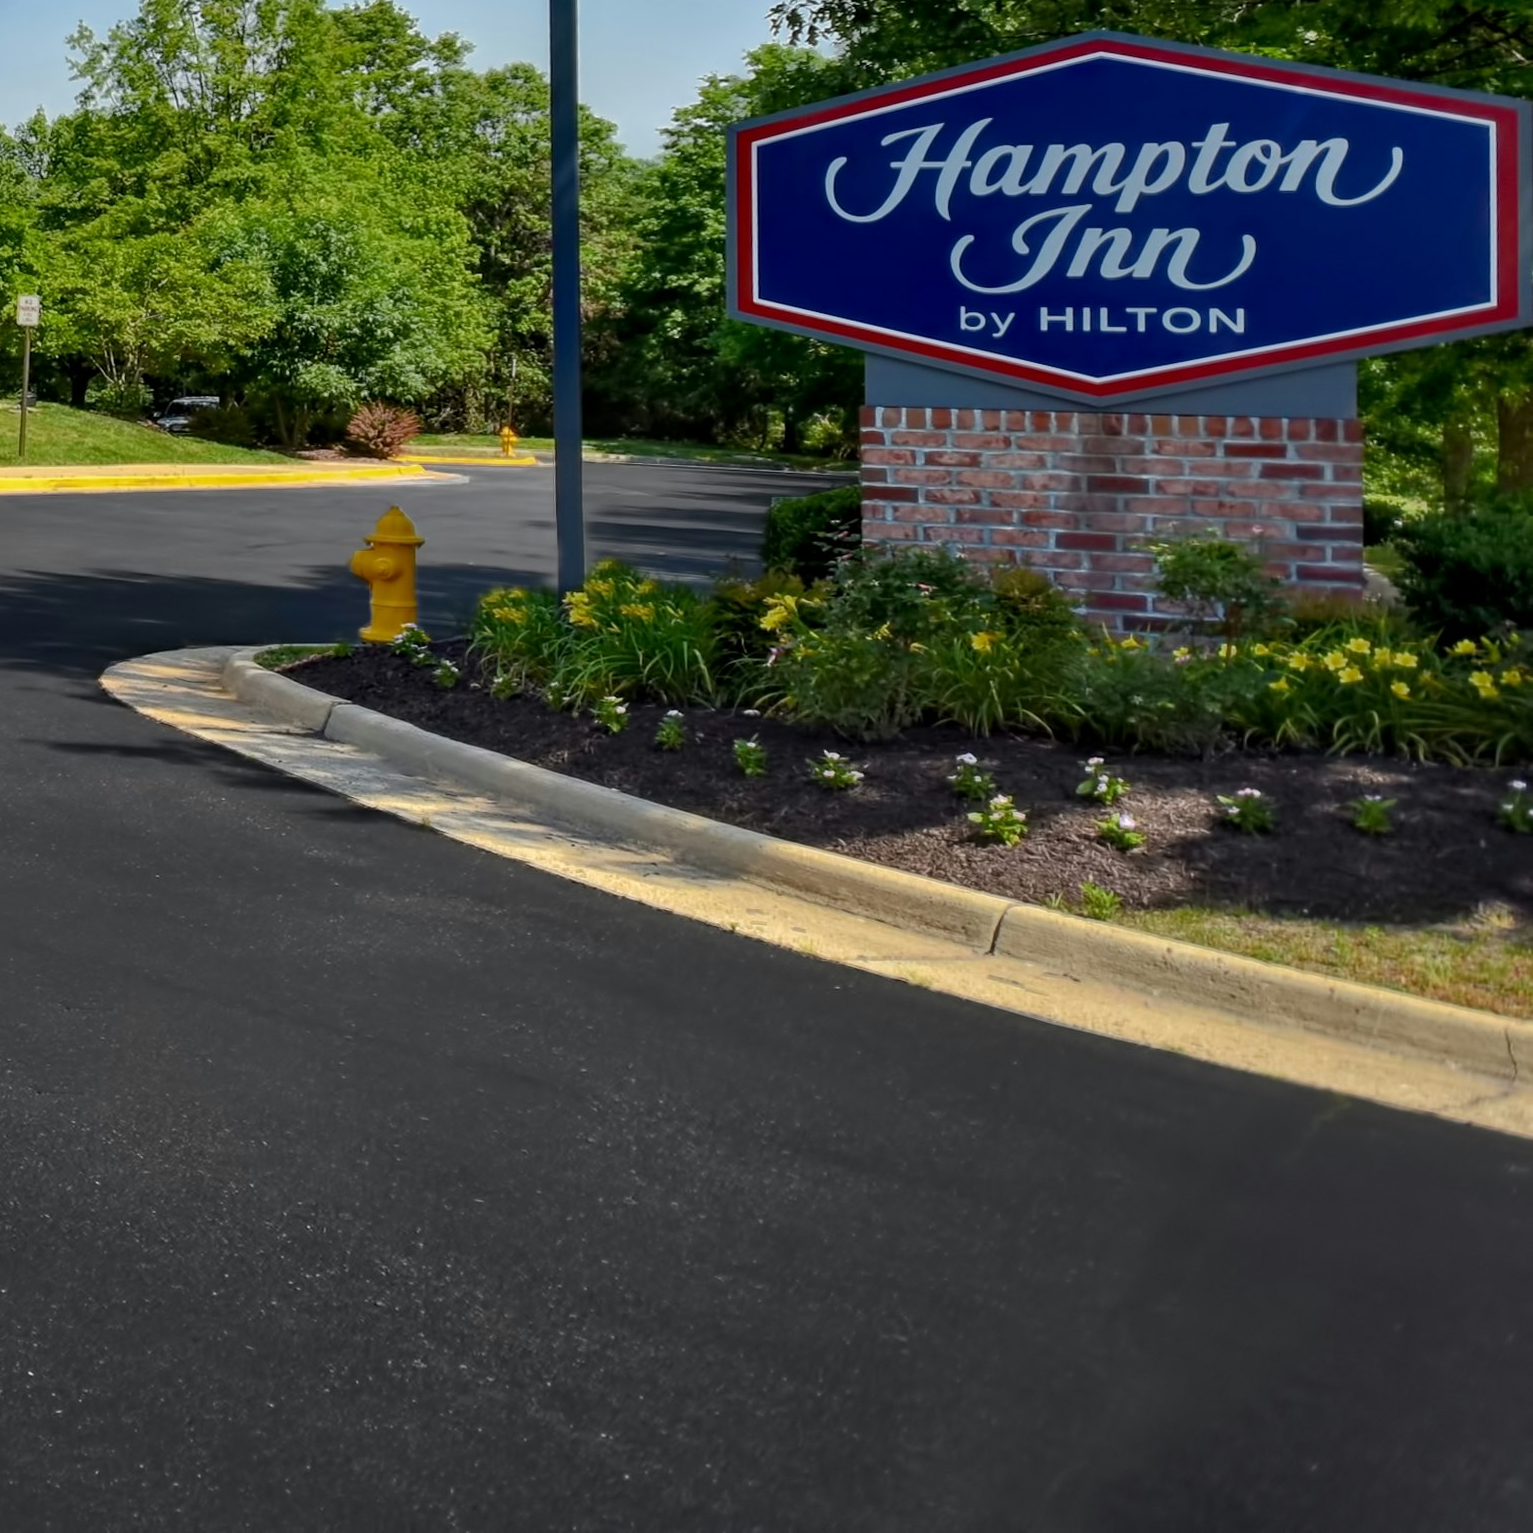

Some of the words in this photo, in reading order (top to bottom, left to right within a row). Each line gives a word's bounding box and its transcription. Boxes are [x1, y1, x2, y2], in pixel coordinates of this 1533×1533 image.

[825, 117, 1403, 223] Hampton
[950, 203, 1256, 294] Inn
[960, 306, 1015, 338] by
[1040, 307, 1245, 334] HILTON
